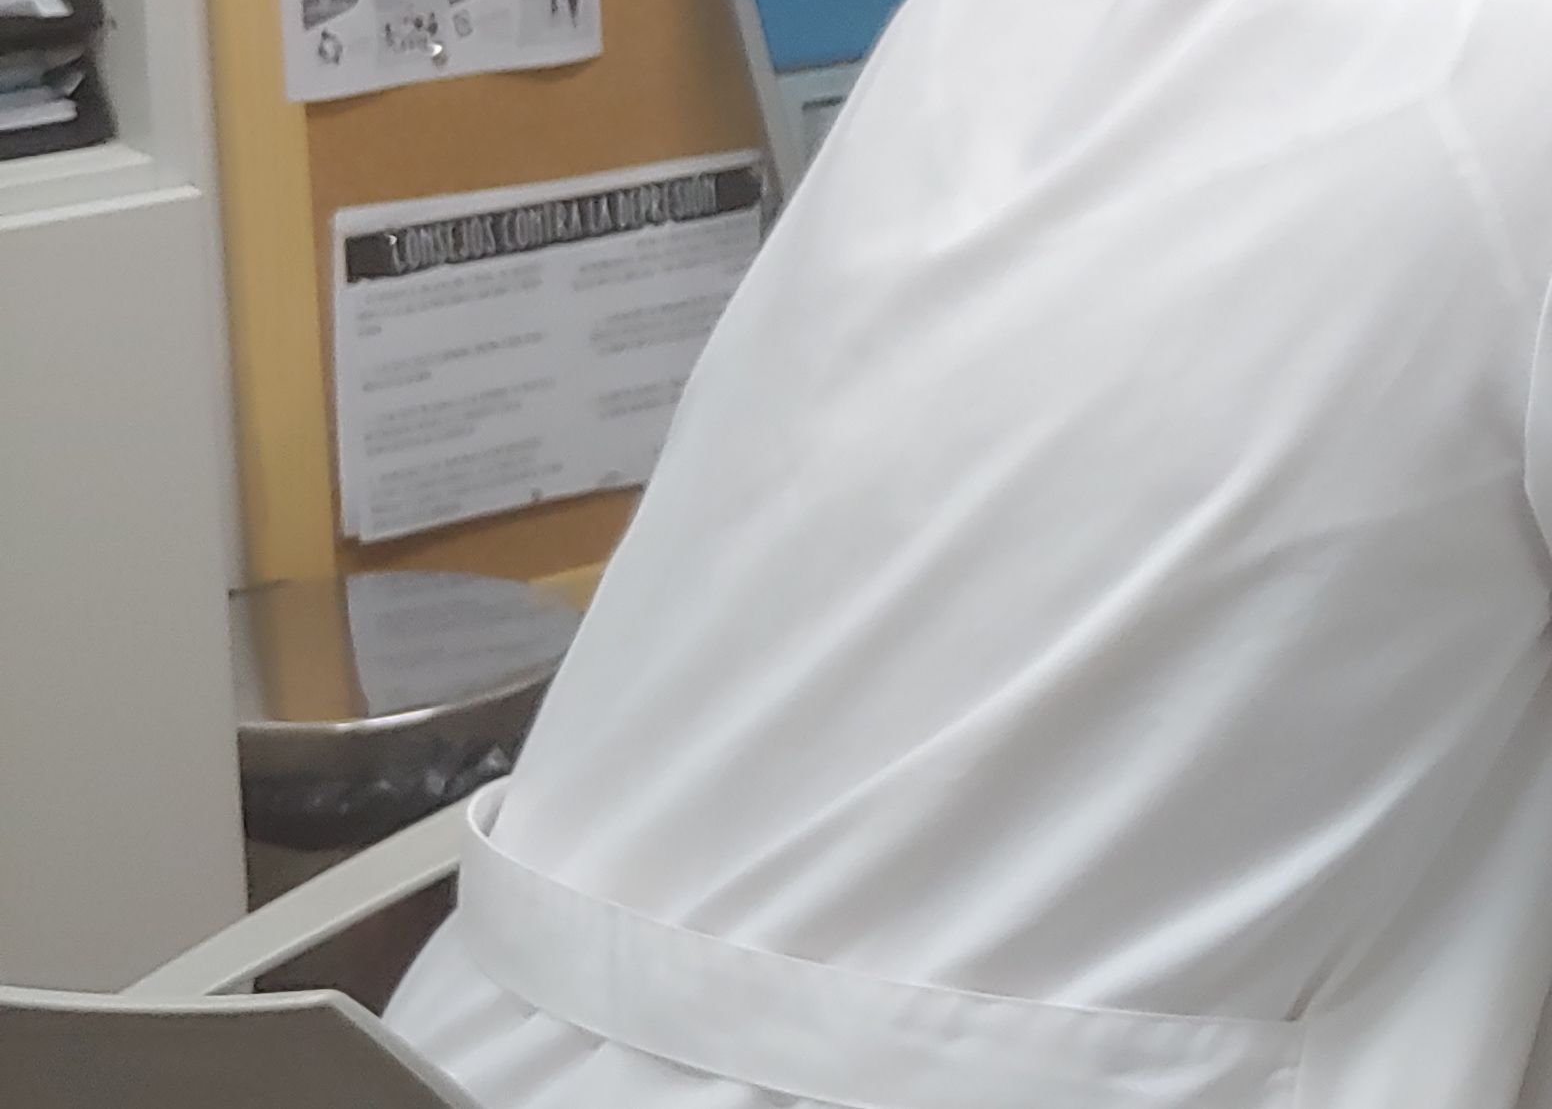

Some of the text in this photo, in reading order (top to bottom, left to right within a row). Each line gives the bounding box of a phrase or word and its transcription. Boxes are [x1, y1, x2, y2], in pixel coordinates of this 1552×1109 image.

[392, 216, 496, 273] CONSEJOS
[502, 199, 583, 253] CONTRA
[588, 194, 613, 232] LA
